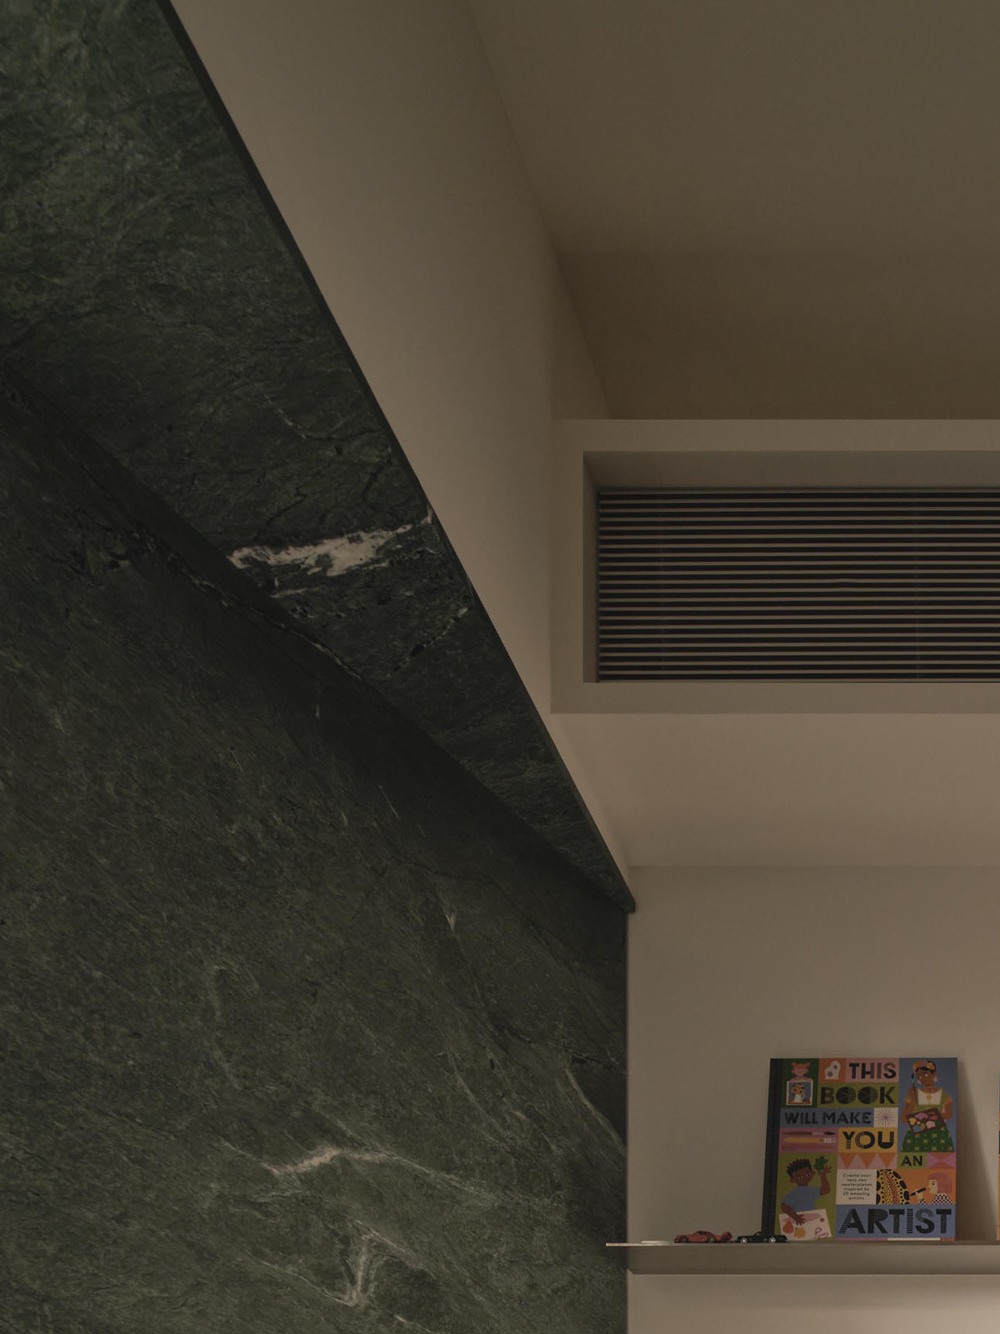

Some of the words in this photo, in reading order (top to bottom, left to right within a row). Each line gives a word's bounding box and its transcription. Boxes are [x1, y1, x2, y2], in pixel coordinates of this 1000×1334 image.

[848, 1062, 897, 1080] THIS
[820, 1086, 896, 1105] BOOK
[784, 1112, 819, 1125] WILL
[823, 1111, 872, 1125] MAKE
[842, 1131, 895, 1150] YOU
[901, 1155, 923, 1167] AN
[838, 1208, 953, 1235] ARTIST
